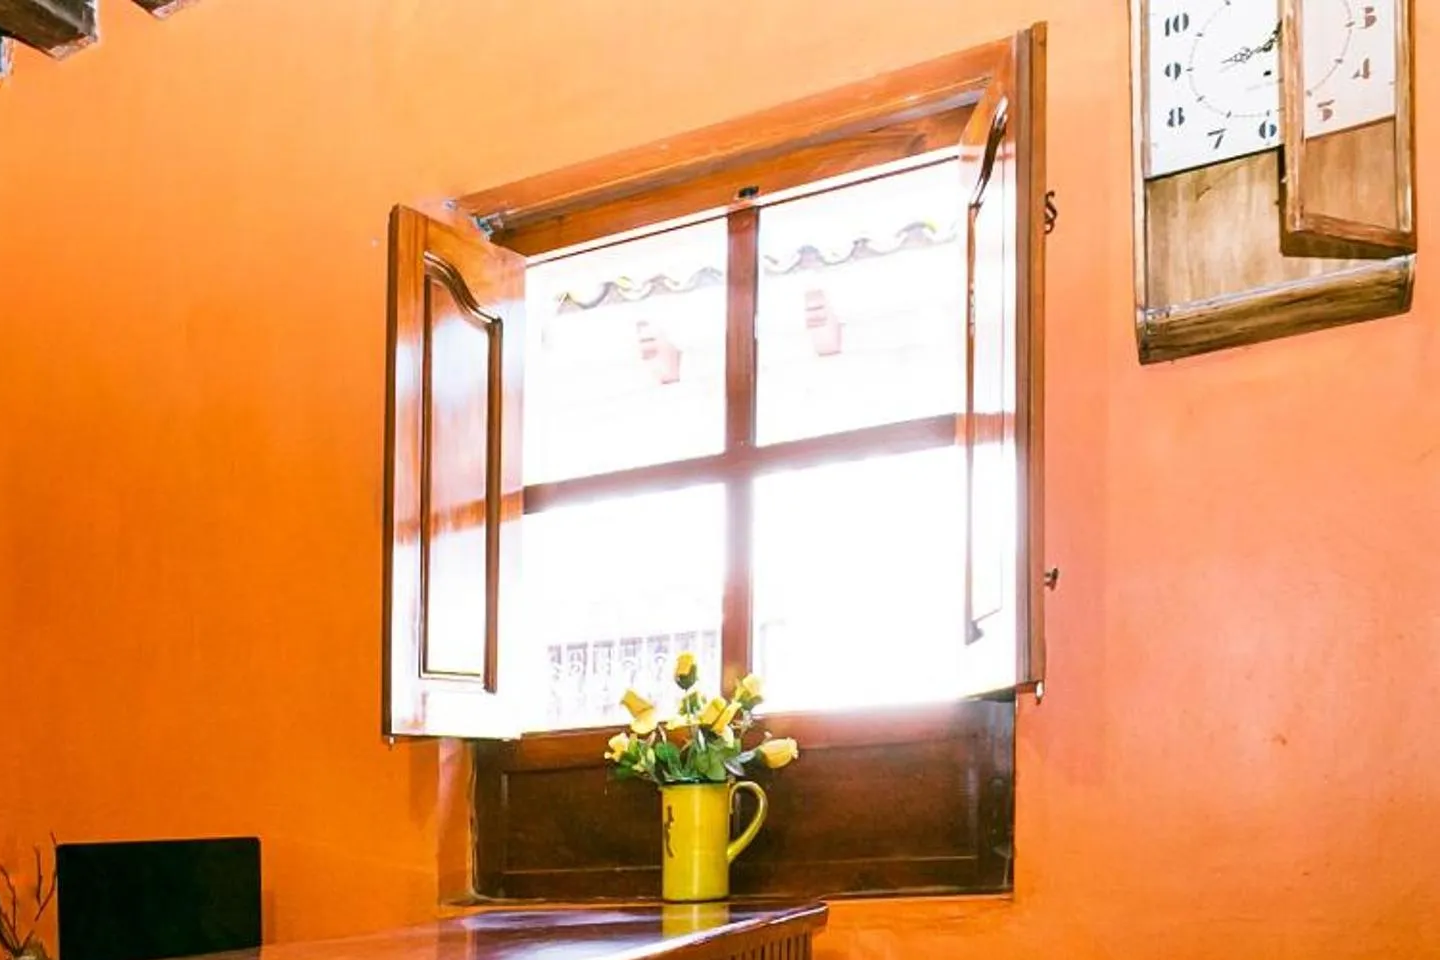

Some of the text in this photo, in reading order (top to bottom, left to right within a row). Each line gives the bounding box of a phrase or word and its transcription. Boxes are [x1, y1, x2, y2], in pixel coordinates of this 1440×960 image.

[1164, 12, 1189, 37] 10
[1352, 57, 1370, 80] 4
[1167, 106, 1185, 128] 8
[1317, 99, 1335, 122] 5
[1207, 128, 1227, 150] 7
